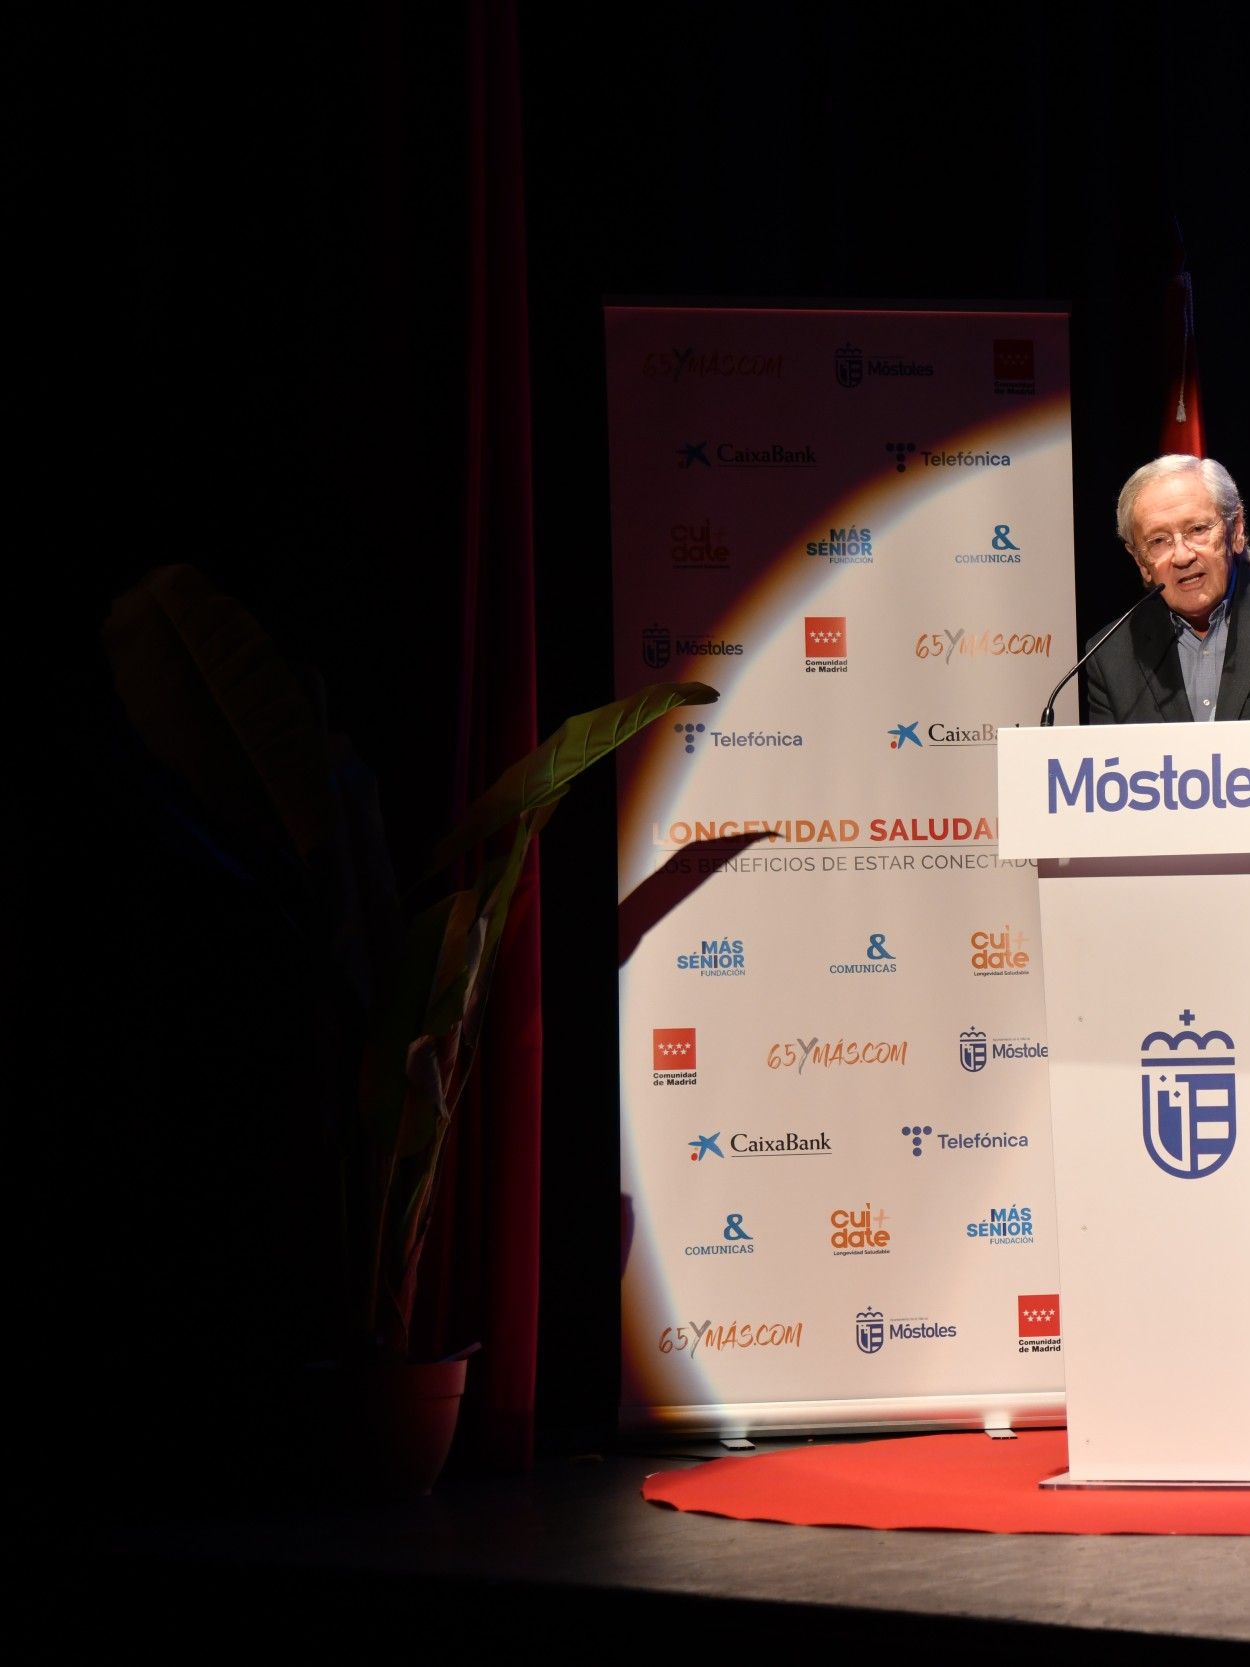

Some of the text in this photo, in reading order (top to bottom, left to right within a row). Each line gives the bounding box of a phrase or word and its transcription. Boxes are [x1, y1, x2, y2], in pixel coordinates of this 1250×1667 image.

[868, 360, 934, 377] Móstoles
[717, 442, 817, 464] CaixaBank
[922, 449, 1011, 467] Telefónica
[830, 525, 871, 542] MÁS
[992, 524, 1020, 551] &
[807, 539, 873, 556] SÉNIOR
[829, 556, 873, 564] FUNDACIÓN
[955, 555, 1021, 564] COMUNICAS
[676, 640, 744, 656] Móstoles
[711, 730, 803, 747] Telefónica
[928, 723, 1019, 742] CaixaB
[652, 817, 998, 845] LONGEVIDAD SALUDA
[656, 858, 691, 874] LOS
[699, 856, 816, 873] BENEFICIOS
[822, 856, 848, 872] DE
[855, 854, 914, 871] ESTAR
[701, 940, 743, 955] MÁS
[867, 933, 896, 960] &
[677, 952, 745, 969] SÉNIOR
[971, 950, 1030, 969] date
[700, 969, 745, 977] FUNDACIÓN
[829, 963, 897, 974] COMUNICAS
[767, 1037, 908, 1075] 65YMÁS.COM
[992, 1042, 1048, 1059] Móstole
[666, 1078, 697, 1086] Madrid
[730, 1132, 832, 1153] CaixaBank
[938, 1132, 1029, 1150] Telefónica
[991, 1204, 1032, 1222] MÁS
[723, 1213, 754, 1240] &
[967, 1219, 1033, 1237] SÉNIOR
[831, 1228, 890, 1248] date
[990, 1236, 1034, 1244] FUNDACIÓN
[685, 1244, 754, 1256] COMUNICAS
[659, 1320, 803, 1359] 65YMÁS.COM
[890, 1322, 957, 1340] Móstoles
[1018, 1338, 1061, 1346] Comunidad
[1032, 1345, 1061, 1353] Madrid
